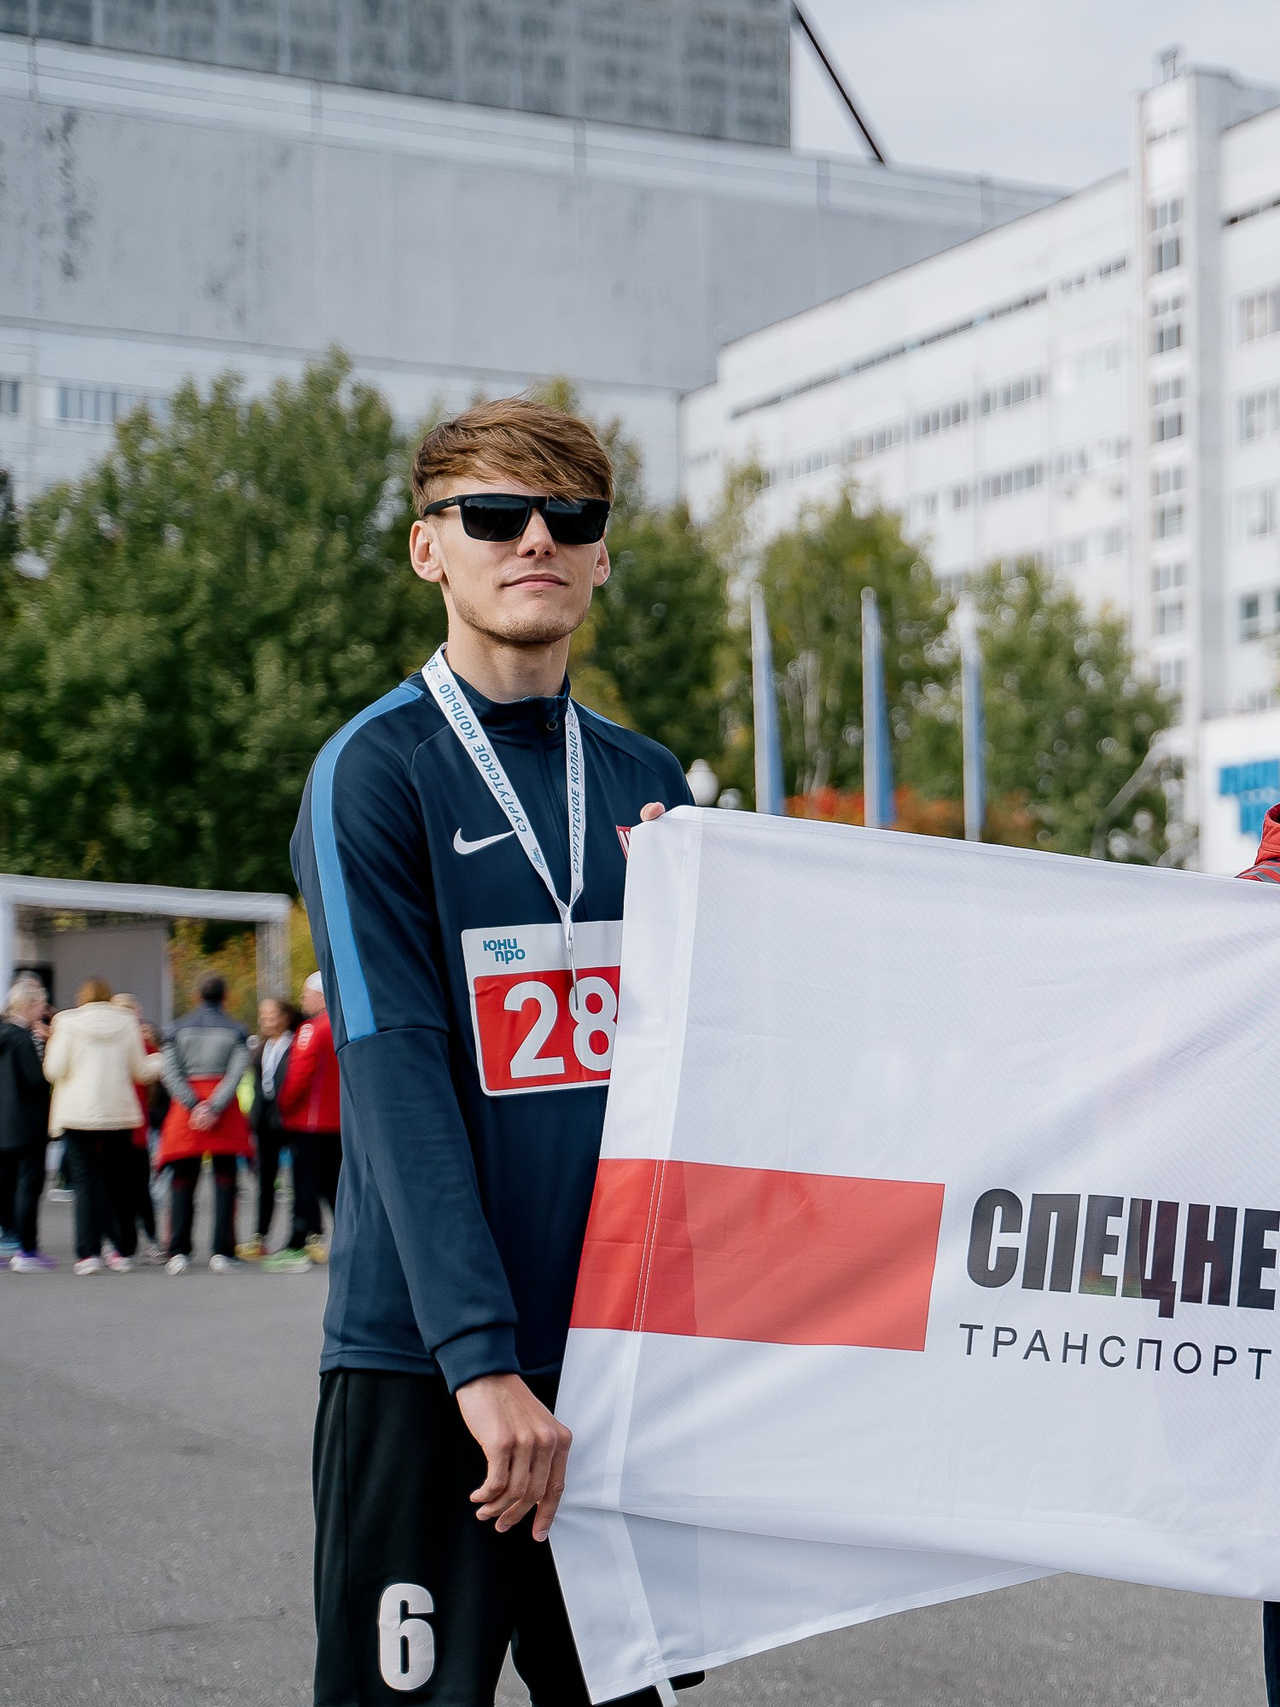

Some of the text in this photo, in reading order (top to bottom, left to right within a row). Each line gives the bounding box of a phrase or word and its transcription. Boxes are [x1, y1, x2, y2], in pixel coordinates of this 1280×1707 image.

[438, 683, 478, 742] КОЛЬЦО
[473, 744, 527, 833] СУРГУТСКОЕ
[568, 730, 580, 874] СУРГУТСКОЕ КОЛЬЦО
[483, 938, 517, 951] юни
[494, 949, 525, 964] про
[503, 976, 618, 1079] 28
[379, 1583, 435, 1691] 6
